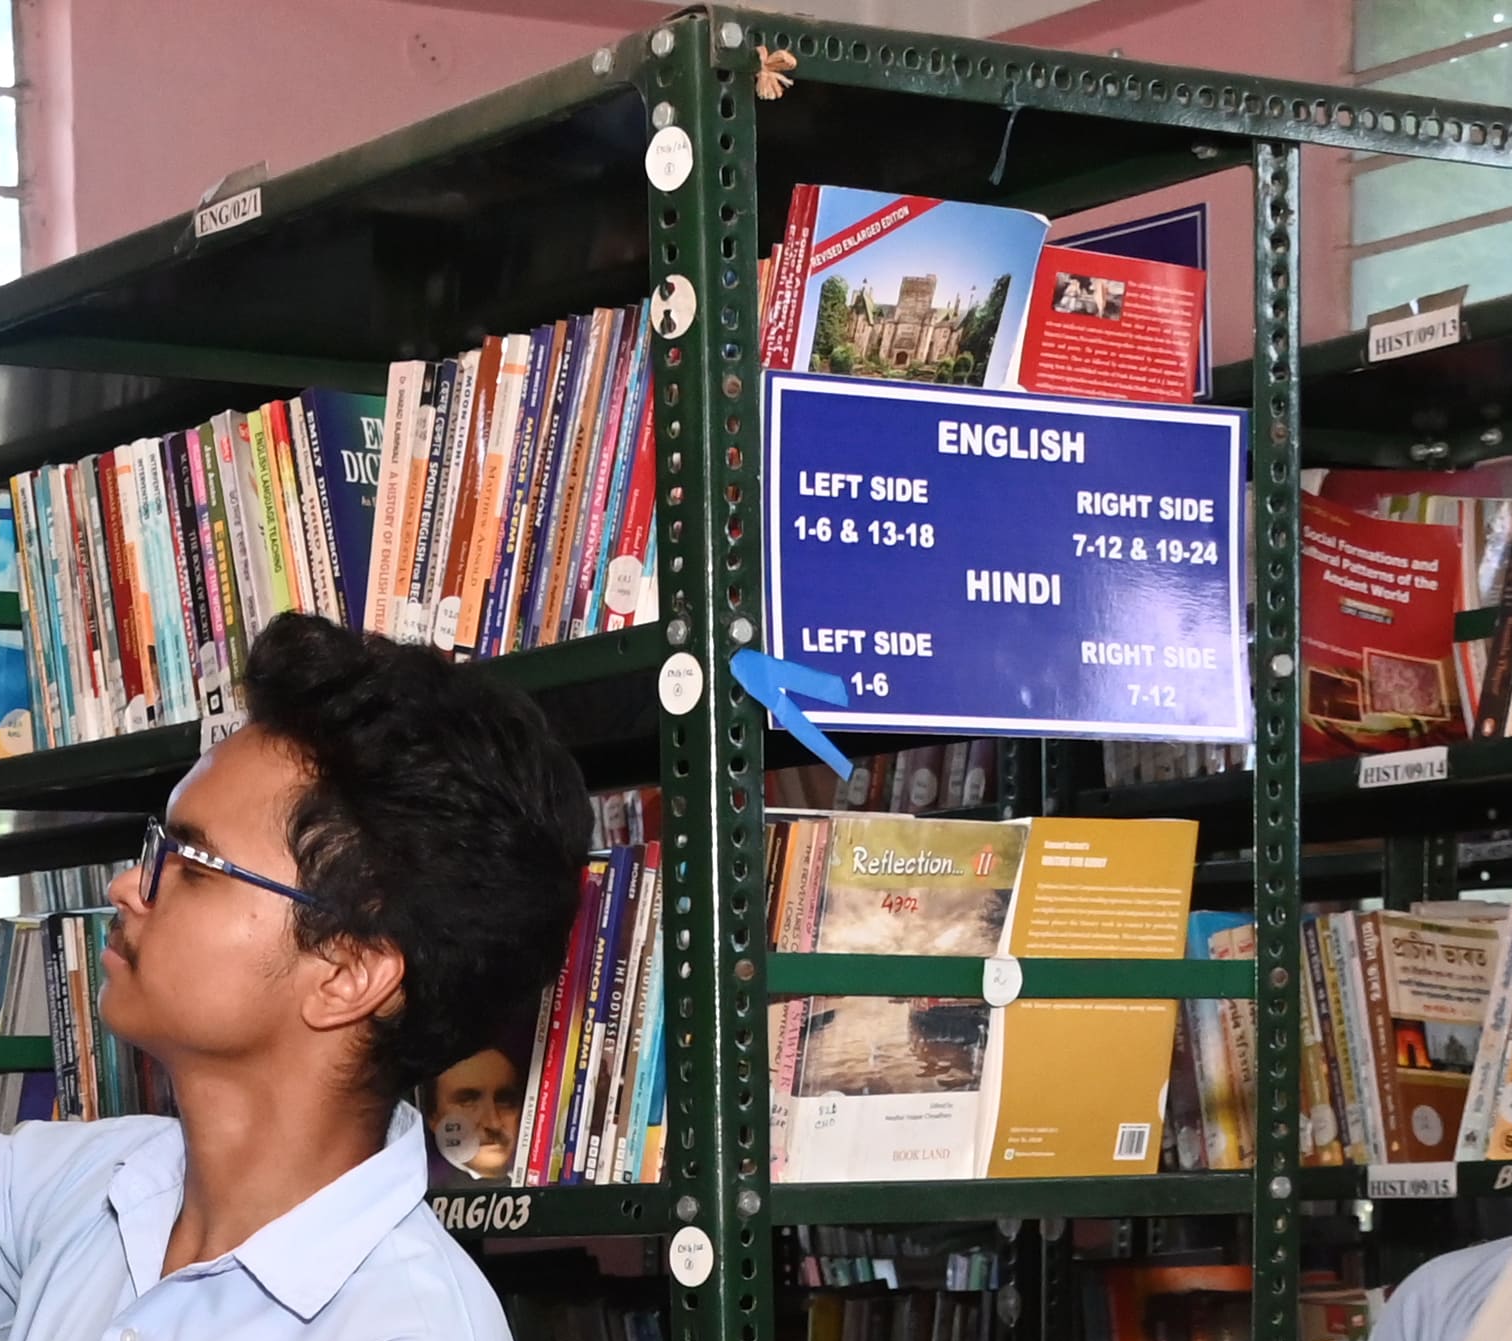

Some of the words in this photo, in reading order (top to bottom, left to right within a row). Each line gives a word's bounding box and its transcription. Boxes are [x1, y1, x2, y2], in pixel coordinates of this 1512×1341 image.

[811, 239, 843, 268] REVISED
[842, 221, 881, 253] ENLARGED
[881, 204, 911, 232] EDITION
[1374, 320, 1459, 356] HIST/09/13
[558, 339, 573, 404] EMILY
[517, 417, 534, 484] MINOR
[939, 421, 1084, 463] ENGLISH
[306, 411, 324, 477] EMILY
[316, 479, 342, 579] DICKINSON
[535, 414, 561, 527] DICKINSON
[506, 486, 524, 553] POEMS
[800, 471, 862, 498] LEFT
[871, 476, 928, 503] SIDE
[1078, 491, 1152, 518] RIGHT
[1159, 497, 1213, 522] SIDE
[795, 516, 831, 541] 1-6
[840, 519, 858, 543] &
[869, 521, 934, 547] 13-18
[1073, 534, 1122, 559] 7-12
[1130, 538, 1147, 560] &
[1156, 539, 1217, 564] 19-24
[1303, 525, 1334, 550] Social
[1337, 538, 1408, 570] Formations
[1411, 557, 1438, 574] and
[967, 570, 1060, 605] HINDI
[1323, 571, 1369, 593] Ancient
[1372, 581, 1409, 604] World
[1342, 557, 1394, 582] Patterns
[1413, 575, 1438, 591] the
[803, 628, 865, 653] LEFT
[875, 631, 932, 656] SIDE
[1081, 641, 1158, 667] RIGHT
[1164, 644, 1216, 670] SIDE
[851, 672, 888, 696] 1-6
[1128, 684, 1176, 708] 7-12
[1363, 760, 1447, 785] HIST/09/14
[589, 936, 606, 1003] MINOR
[615, 958, 626, 984] THE
[578, 1005, 596, 1071] POEMS
[603, 986, 623, 1054] ODYSSEY
